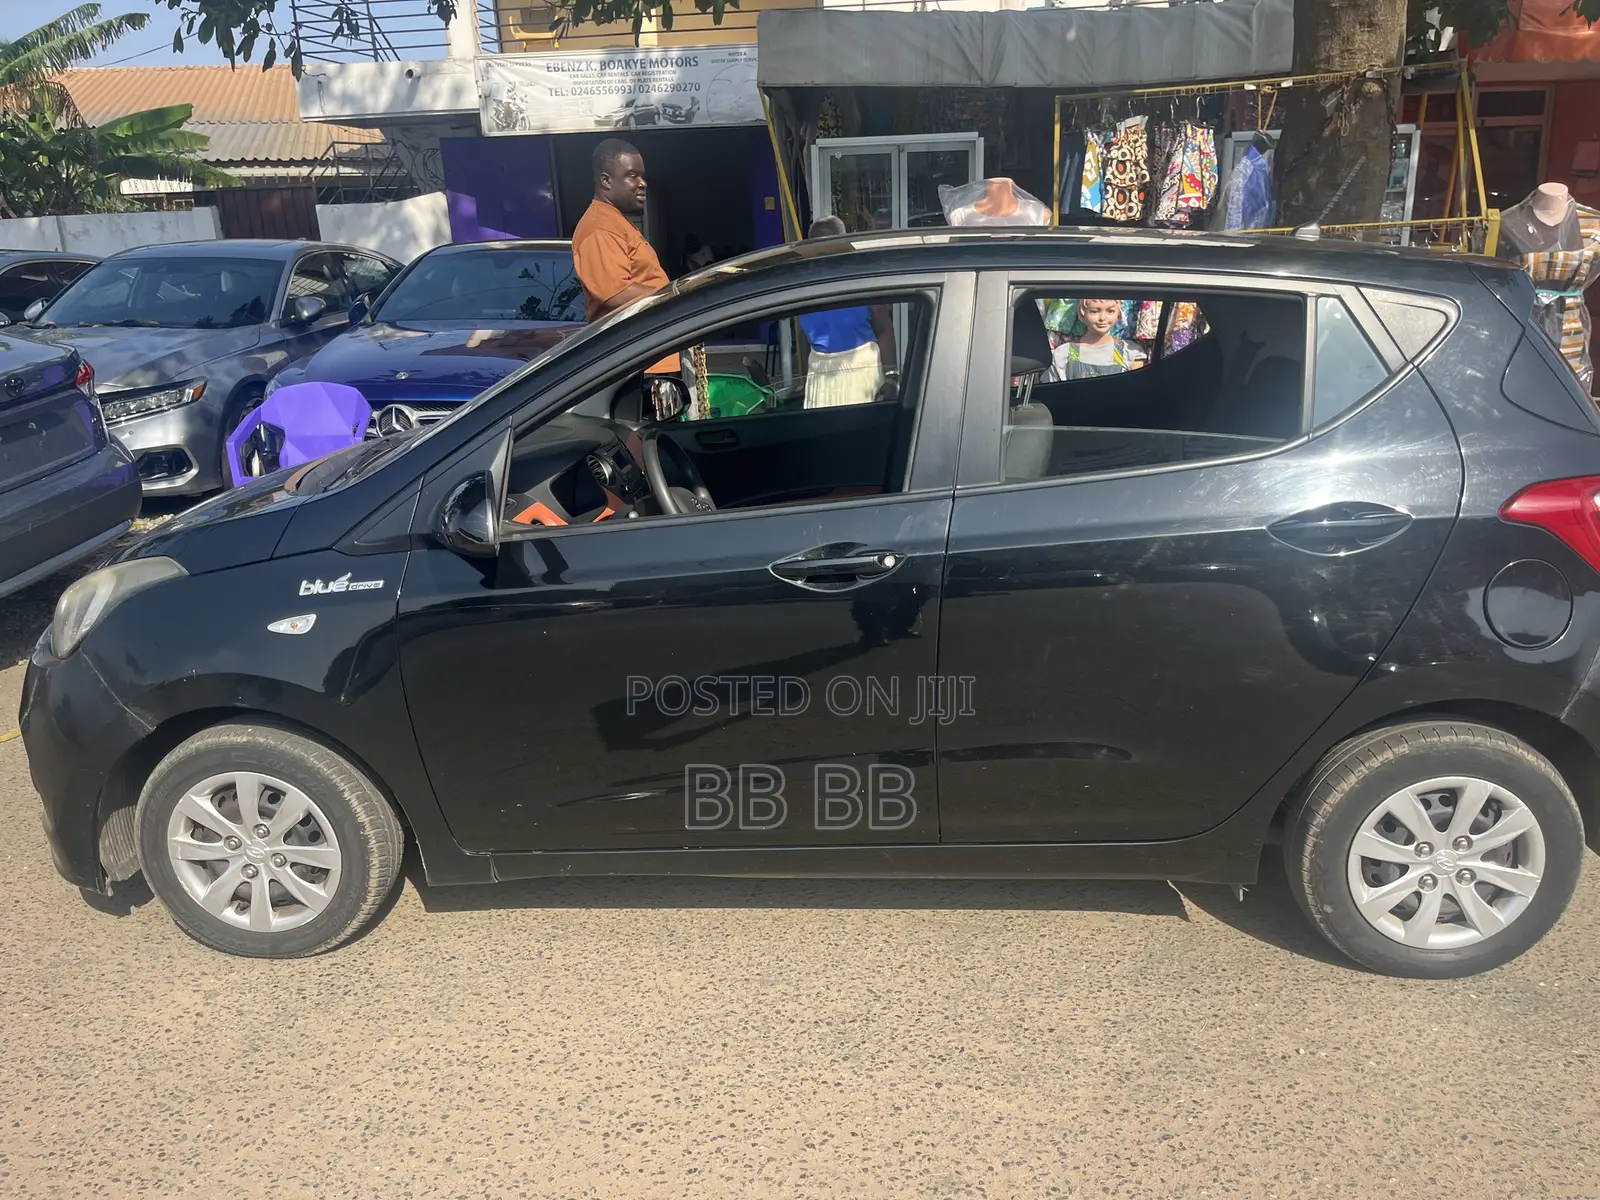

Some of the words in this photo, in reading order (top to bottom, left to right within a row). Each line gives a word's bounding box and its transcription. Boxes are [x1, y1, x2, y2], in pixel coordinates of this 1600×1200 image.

[546, 60, 583, 72] EBENZ
[585, 60, 597, 71] K.
[599, 58, 646, 71] BOAKYE
[648, 56, 699, 69] MOTORS
[548, 86, 569, 97] TEL:
[638, 82, 701, 94] 0246290270
[350, 581, 382, 591] drive
